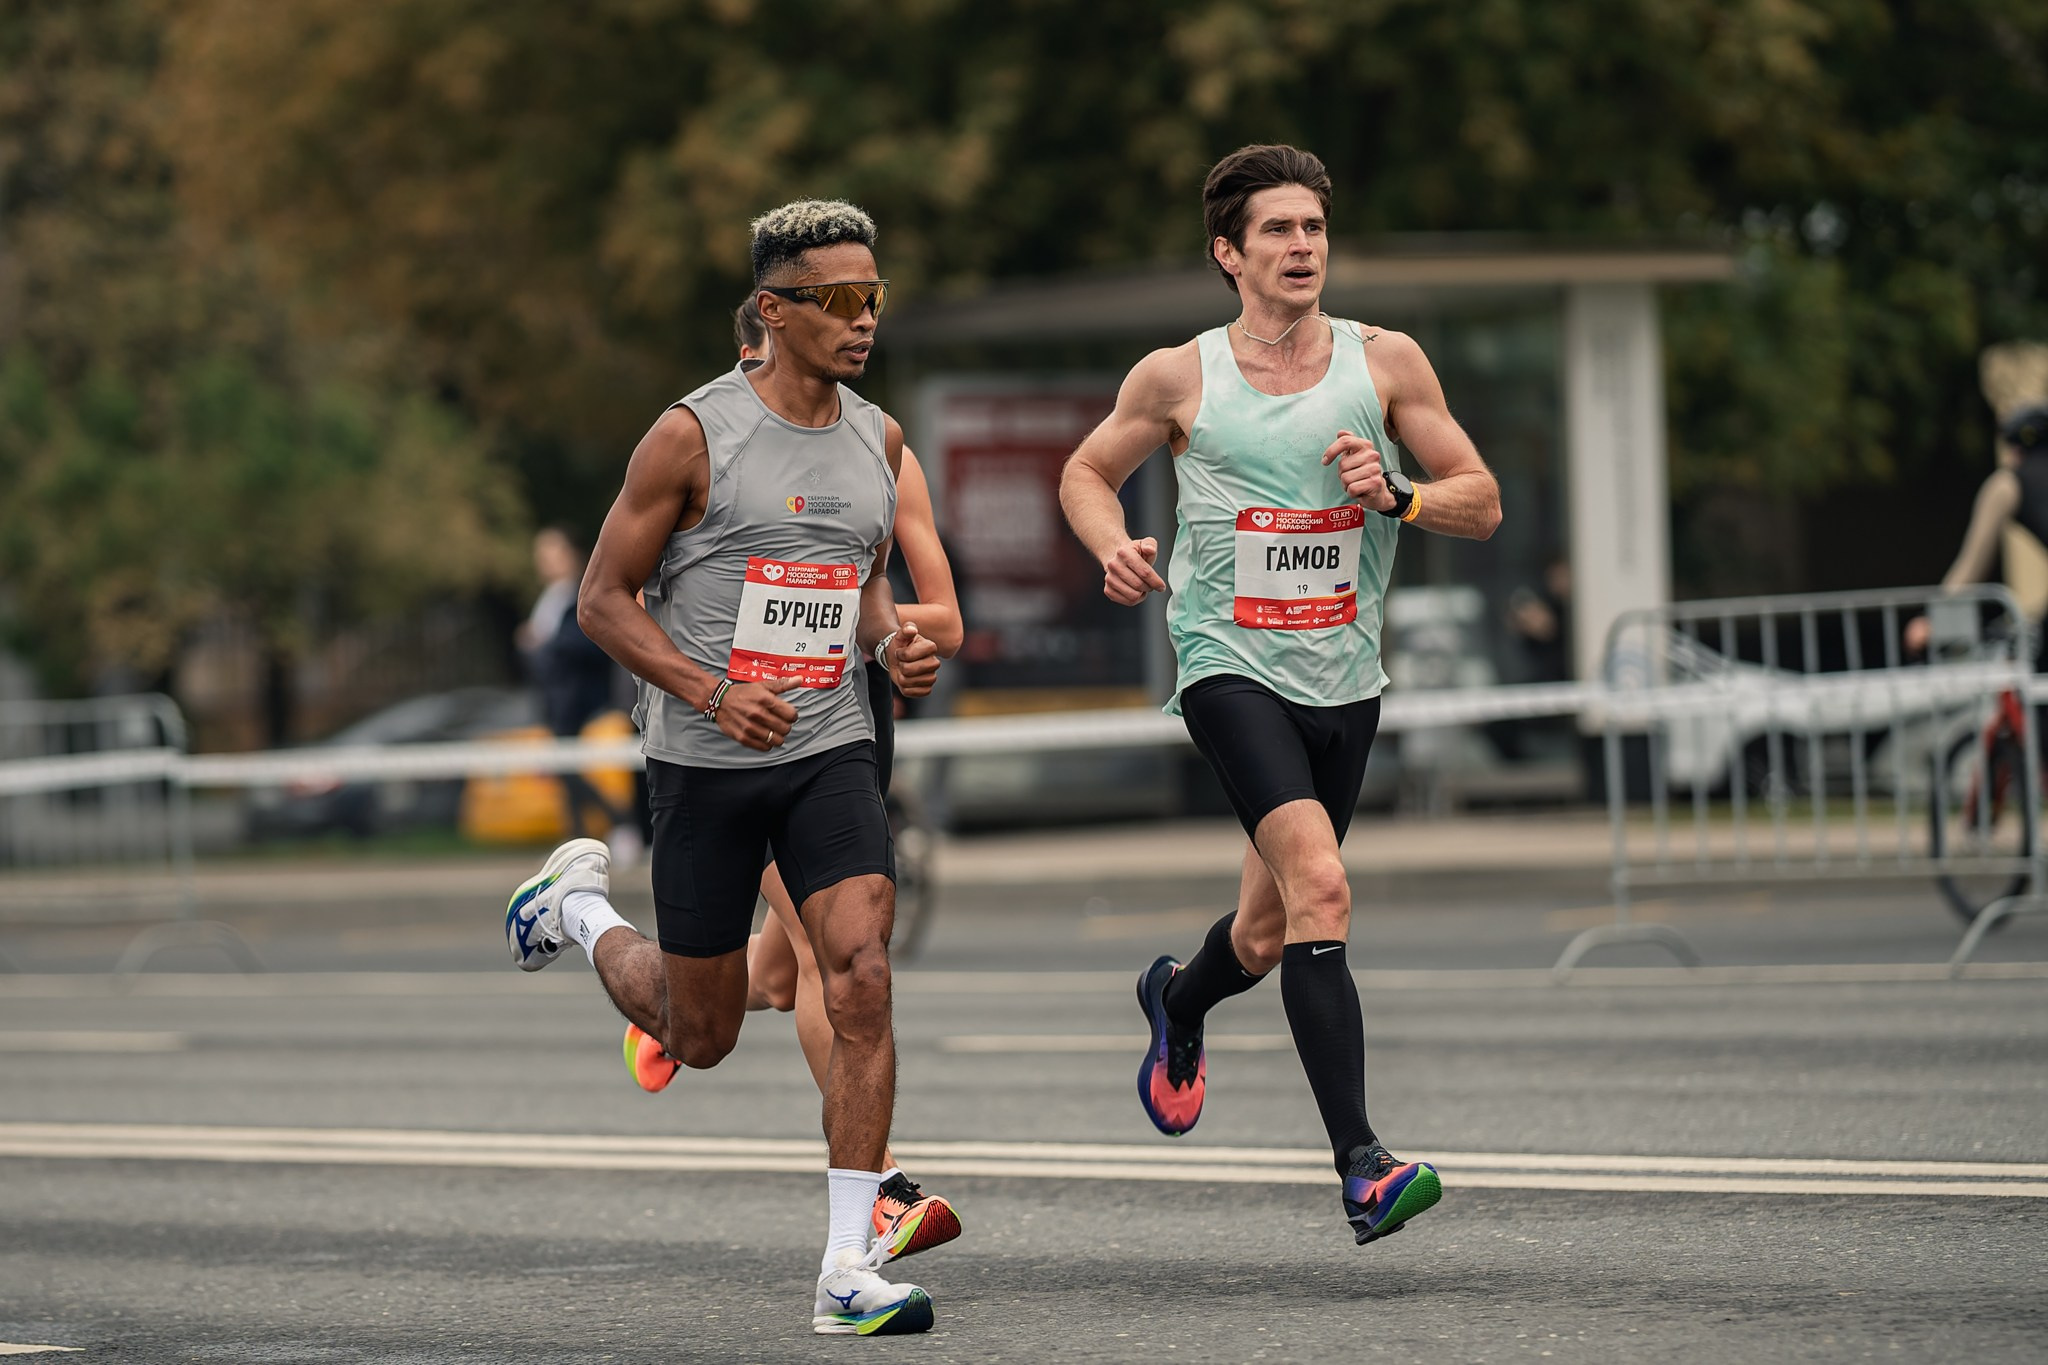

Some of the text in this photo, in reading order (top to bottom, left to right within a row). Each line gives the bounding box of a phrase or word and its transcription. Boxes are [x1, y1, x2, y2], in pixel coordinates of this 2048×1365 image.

[1266, 545, 1341, 571] ГАМОВ
[786, 571, 829, 580] МОСКОВСКИЙ
[785, 578, 817, 586] МАРАФОН
[1297, 584, 1308, 594] 19
[763, 599, 843, 633] БУРЦЕВ
[795, 642, 807, 652] 29
